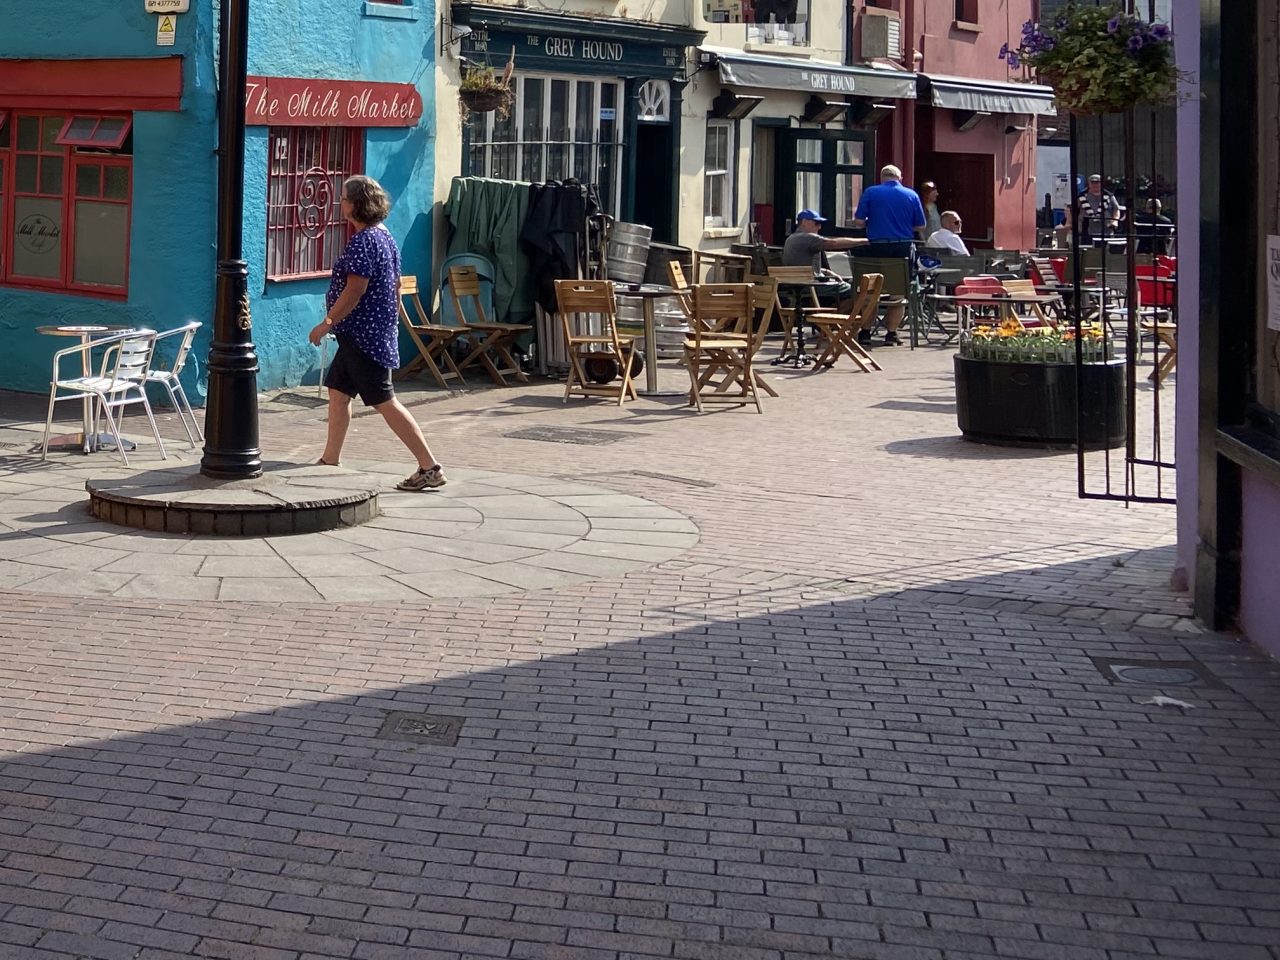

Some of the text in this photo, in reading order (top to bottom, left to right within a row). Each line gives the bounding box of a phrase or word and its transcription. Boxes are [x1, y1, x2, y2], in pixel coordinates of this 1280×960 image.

[527, 35, 624, 61] THE GREY HOUND
[811, 73, 828, 89] GREY
[830, 74, 855, 91] HOUND
[287, 86, 340, 118] Milk
[347, 88, 416, 119] Market
